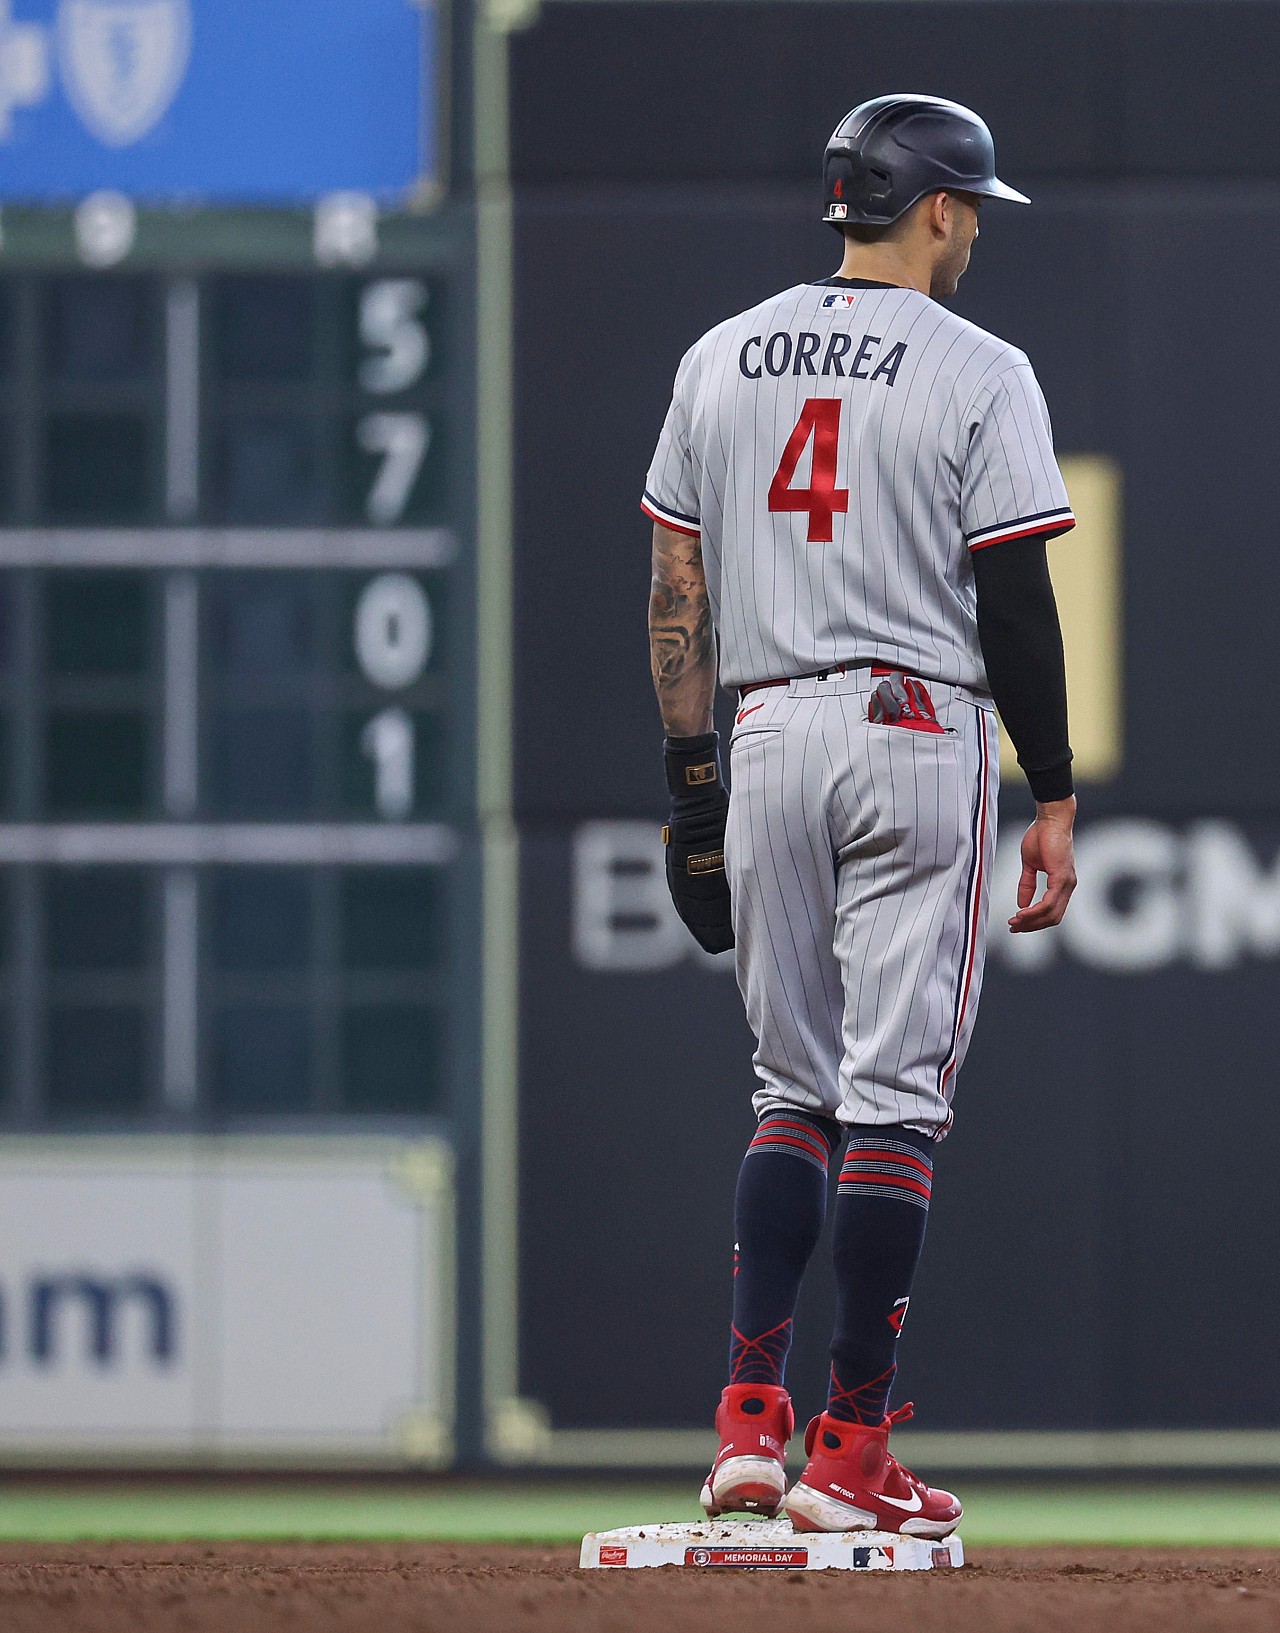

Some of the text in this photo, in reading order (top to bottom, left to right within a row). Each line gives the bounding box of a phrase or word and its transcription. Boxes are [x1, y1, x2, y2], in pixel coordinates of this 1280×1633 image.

[833, 178, 843, 199] 4
[360, 278, 428, 394] 5
[739, 331, 908, 387] CORREA
[362, 411, 428, 524] 7
[768, 398, 849, 542] 4
[354, 572, 430, 689] 0
[364, 706, 413, 820] 1
[0, 1268, 180, 1371] m
[724, 1553, 793, 1562] MEMORIAL DAY
